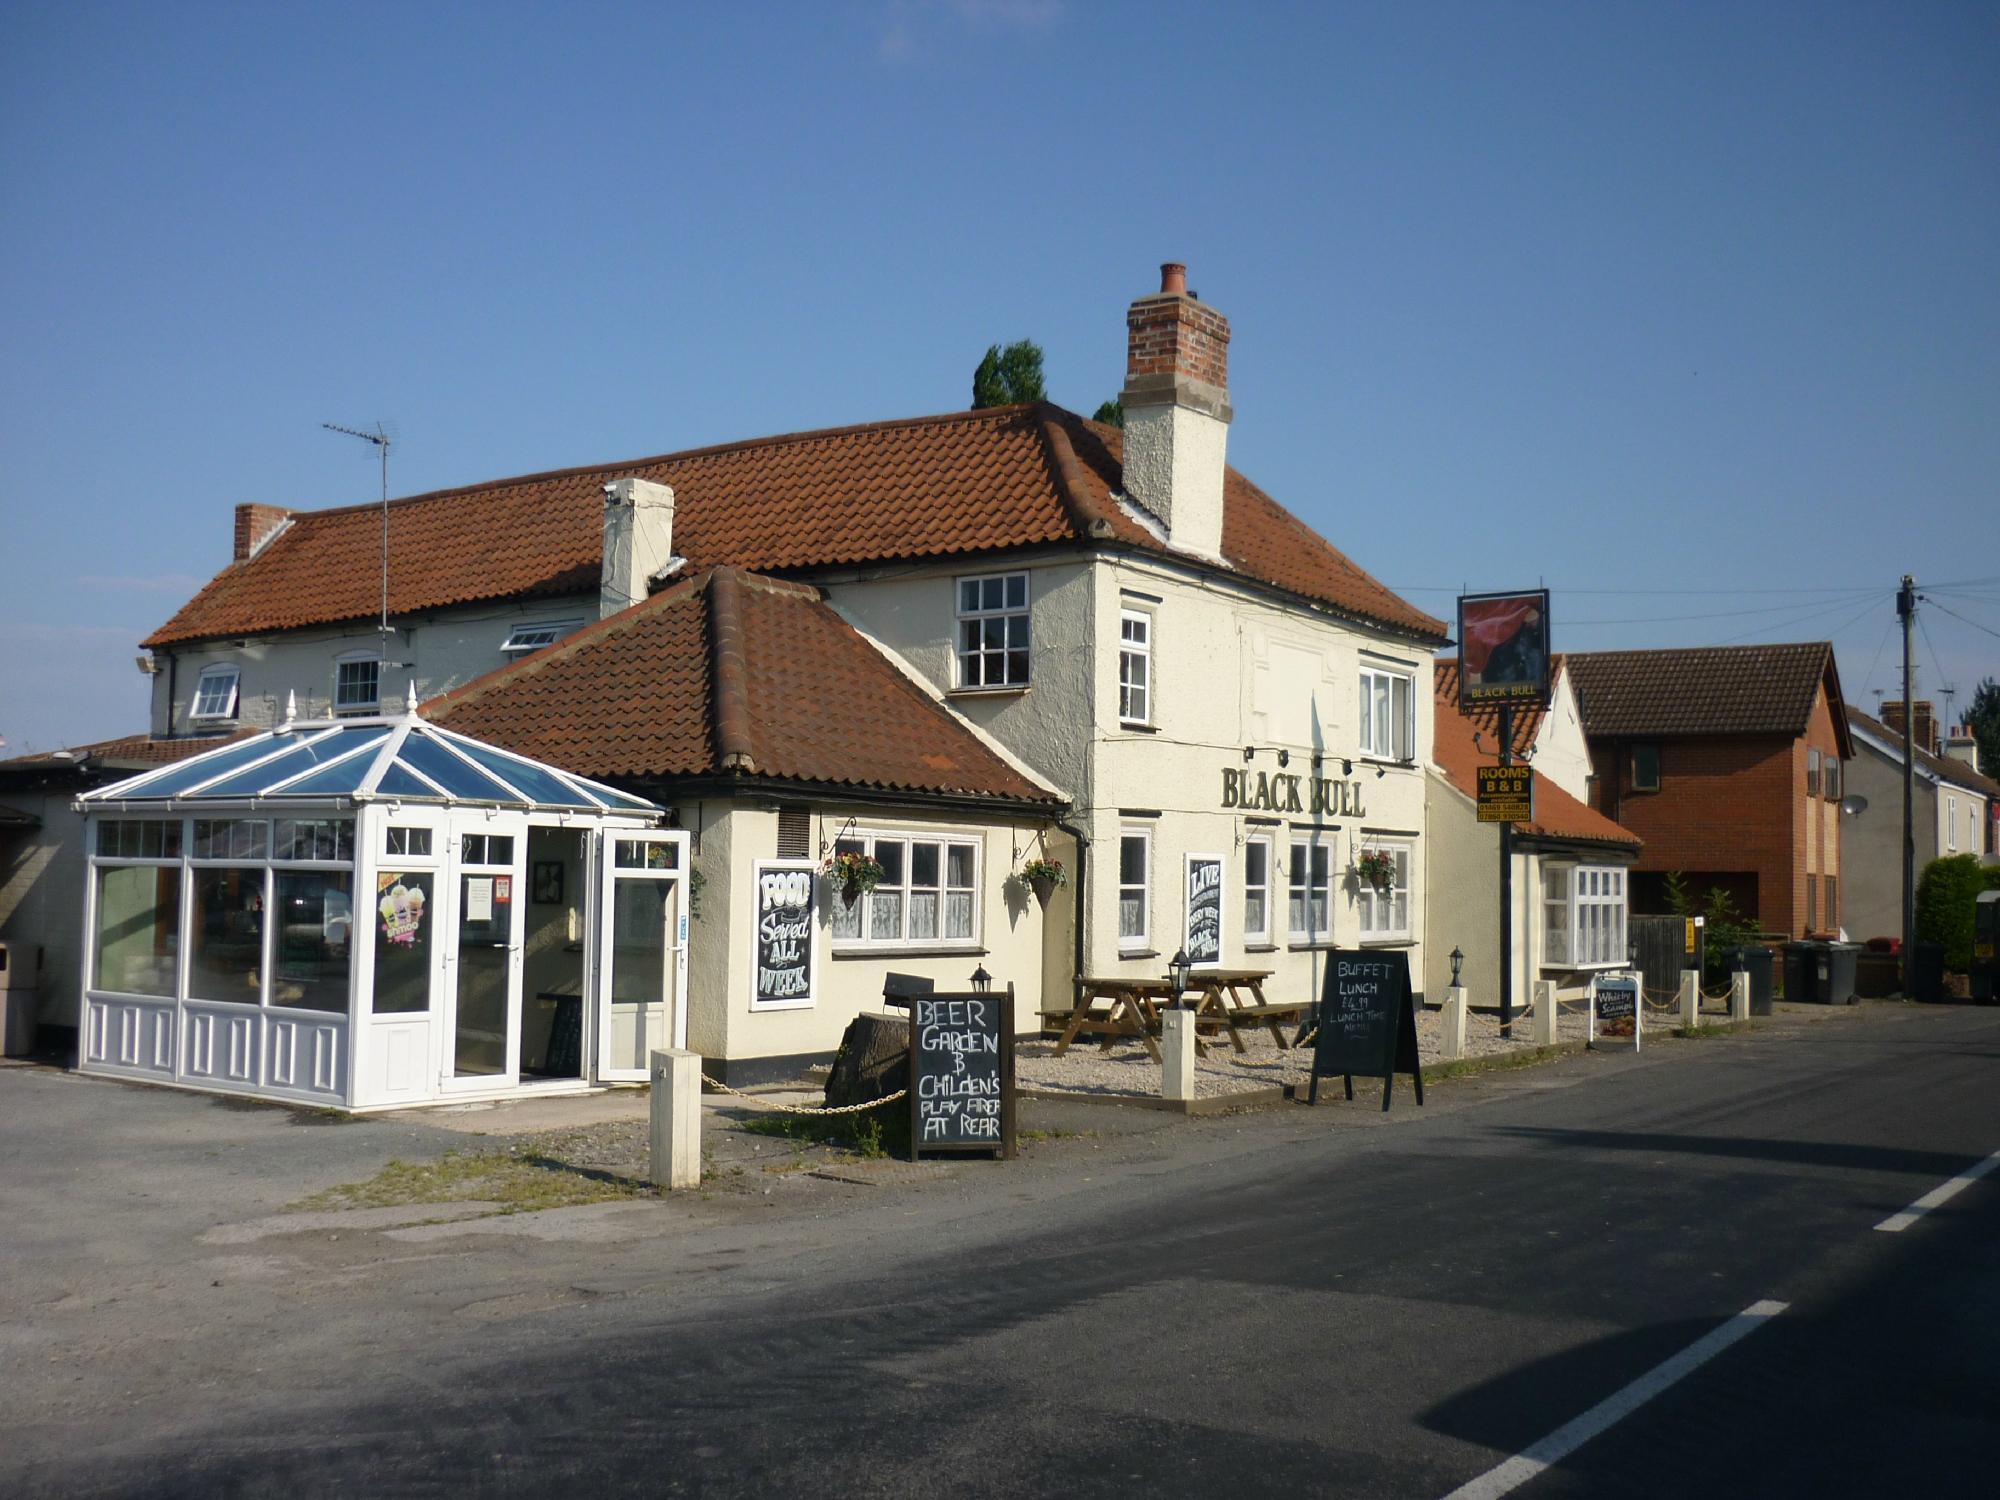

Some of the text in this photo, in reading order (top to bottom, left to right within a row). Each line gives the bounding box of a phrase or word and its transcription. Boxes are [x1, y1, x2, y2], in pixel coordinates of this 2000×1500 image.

[1471, 685, 1536, 698] BLACK BULL
[1480, 767, 1529, 779] ROOMS
[1221, 767, 1366, 817] BLACK BULL
[1487, 780, 1522, 792] B & B
[760, 872, 810, 910] FOOD
[1191, 864, 1220, 900] LIVE
[761, 913, 810, 944] Served
[1189, 928, 1212, 953] BLACK
[770, 940, 800, 963] ALL
[1338, 961, 1394, 979] BUFFET
[760, 966, 809, 996] WEEK
[1339, 981, 1377, 995] LUNCH
[1599, 991, 1631, 1003] Whitby
[916, 1000, 986, 1026] BEER
[1330, 1012, 1363, 1023] LUNCH
[1602, 1001, 1634, 1014] Scampi
[921, 1100, 962, 1118] PLAY
[924, 1113, 999, 1141] AT REAR
